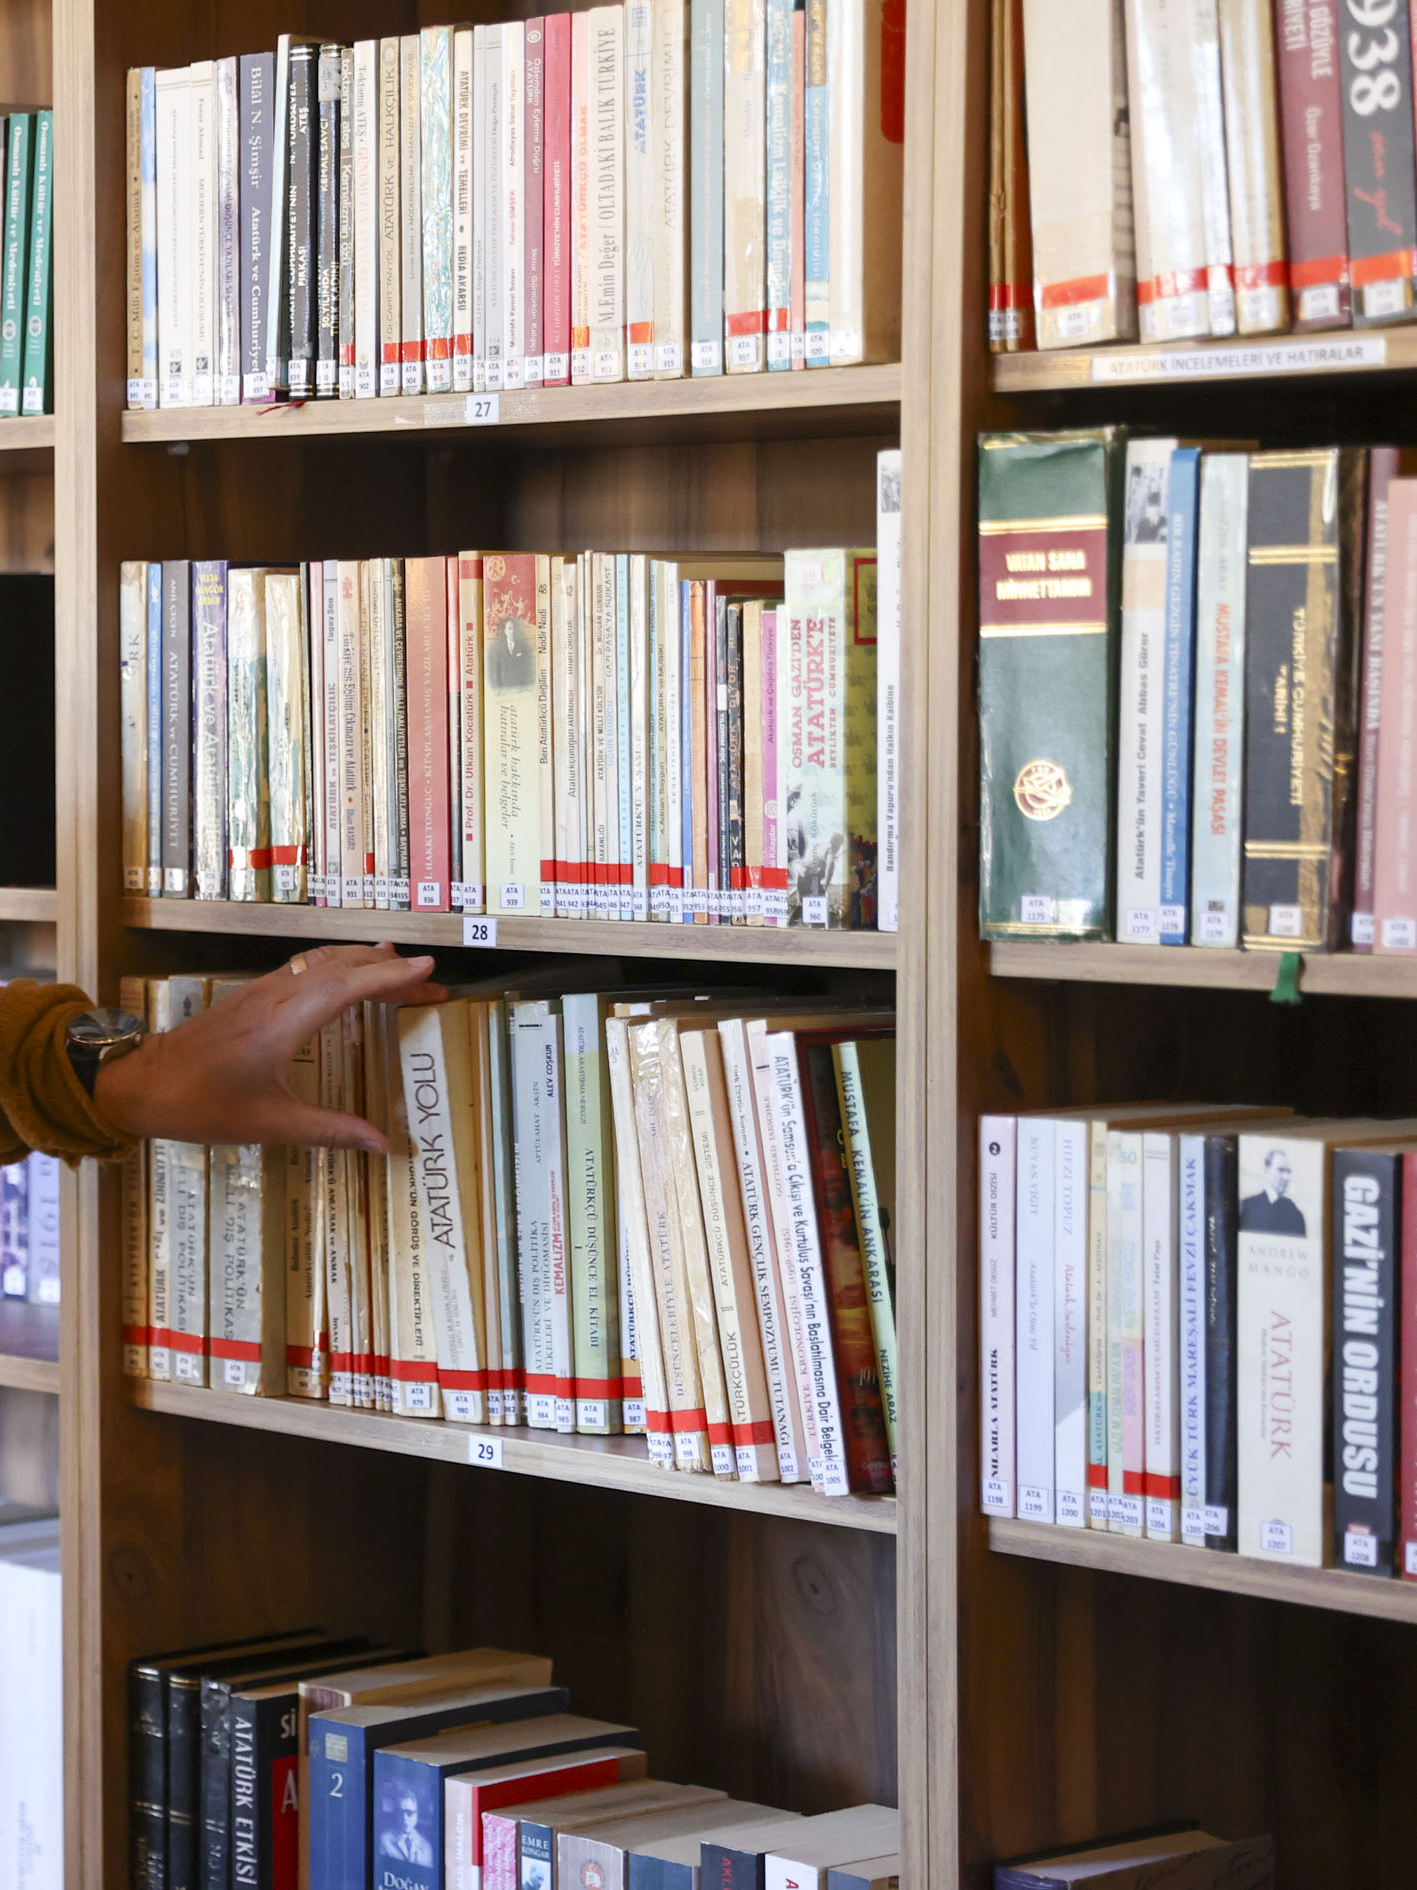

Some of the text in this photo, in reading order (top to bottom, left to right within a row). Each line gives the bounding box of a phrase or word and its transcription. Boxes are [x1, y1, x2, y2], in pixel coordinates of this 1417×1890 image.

[460, 71, 472, 110] ATATÜRK
[526, 59, 534, 104] ATATÜRK
[248, 66, 263, 189] Bilâl N. Şimşir
[459, 112, 470, 151] DEVRİMİ
[533, 108, 542, 143] Eyleme
[384, 68, 398, 241] ATATÜRK VE HALKÇILIK
[532, 145, 542, 174] Doğru
[593, 27, 619, 323] M.Emin Değer OLTADAKİ BALIK TÜRKİYE
[458, 169, 469, 216] TEMELLERİ
[249, 206, 263, 373] Atatürk ve Cumhuriyet
[457, 245, 468, 311] BEDİA AKARSU
[1109, 346, 1364, 375] ATATÜRK İNCELEMELERİ VE HATIRALAR
[474, 401, 492, 418] 27
[394, 598, 404, 626] ANKARA
[538, 608, 548, 654] Nadir Nadi
[395, 640, 406, 687] ÇEVRESİNDE
[466, 634, 474, 676] Atatürk
[1137, 631, 1149, 715] Abbas Gürer
[168, 651, 179, 723] ATATÜRK
[344, 683, 356, 711] Eğitim
[790, 618, 803, 769] OSMAN GAZİ'DEN
[804, 618, 826, 769] ATATÜRK'E
[828, 616, 837, 769] BEYLİKTEN CUMHURİYETE
[397, 710, 406, 758] FAALİYETLER
[538, 668, 549, 765] Ben Atatürkçü Değilim
[1210, 602, 1232, 835] MUSTAFA KEMAL'İN DEVLET PAŞASI
[465, 692, 474, 830] Prof. Dr. Utkan Kocatürk
[1137, 722, 1147, 761] Cevat
[168, 744, 179, 848] CUMHURİYET
[345, 760, 357, 793] Atatürk
[398, 769, 407, 829] TEŞKİLATLANMA
[511, 757, 522, 818] hakkında
[886, 684, 895, 873] Bandırma Vapuru'ndan Halkın Kalbine
[499, 780, 510, 830] belgeler
[1134, 809, 1146, 880] Atatürk'ün
[422, 885, 435, 893] ATA
[423, 895, 435, 904] 936
[506, 886, 519, 894] ATA
[506, 897, 518, 906] 939
[808, 900, 821, 908] ATA
[471, 924, 488, 941] 28
[809, 913, 821, 921] 960
[409, 1052, 441, 1125] YOLU
[545, 1043, 555, 1098] ALEV COŞKUN
[419, 1133, 457, 1250] ATATÜRK
[788, 1172, 805, 1205] Çıkışı
[841, 1071, 884, 1304] MUSTAFA KEMAL'İN ANKARASI
[1185, 1157, 1198, 1236] ÇAKMAK
[550, 1232, 566, 1295] KEMALİZM
[583, 1147, 600, 1348] ATATÜRKÇÜ DÜŞÜNCE EL KİTABI
[793, 1219, 810, 1266] Kurtuluş
[1248, 1244, 1310, 1262] ANDREW
[409, 1210, 424, 1347] GÖRÜŞ VE DİREKTİFLERİ
[1184, 1242, 1198, 1293] FEVZİ
[1248, 1262, 1311, 1279] MANGO
[530, 1219, 542, 1371] ATATÜRK'ÜN DIŞ POLİTİKA
[543, 1299, 552, 1313] VE
[742, 1161, 790, 1447] ATATÜRK GENÇLİK SEMPOZYUMU TUTANAĞI
[799, 1266, 816, 1322] Savaşı'nın
[806, 1322, 827, 1398] Başlatılmasına
[1185, 1296, 1200, 1389] MAREŞALİ
[1341, 1173, 1386, 1500] GAZİ'NİN ORDUSU
[879, 1349, 897, 1425] NEZİHE ARAZ
[1269, 1308, 1297, 1462] ATATÜRK
[583, 1405, 598, 1413] ATA
[584, 1416, 598, 1425] 986
[817, 1401, 832, 1426] Dair
[1186, 1394, 1199, 1441] TÜRK
[477, 1443, 495, 1461] 29
[825, 1463, 839, 1472] ATA
[825, 1475, 841, 1485] 1005
[988, 1482, 1002, 1491] ATA
[234, 1715, 259, 1885] ATATÜRK ETKİSİ
[329, 1772, 344, 1798] 2
[520, 1835, 551, 1850] EMRE
[383, 1870, 430, 1890] DOĞAN
